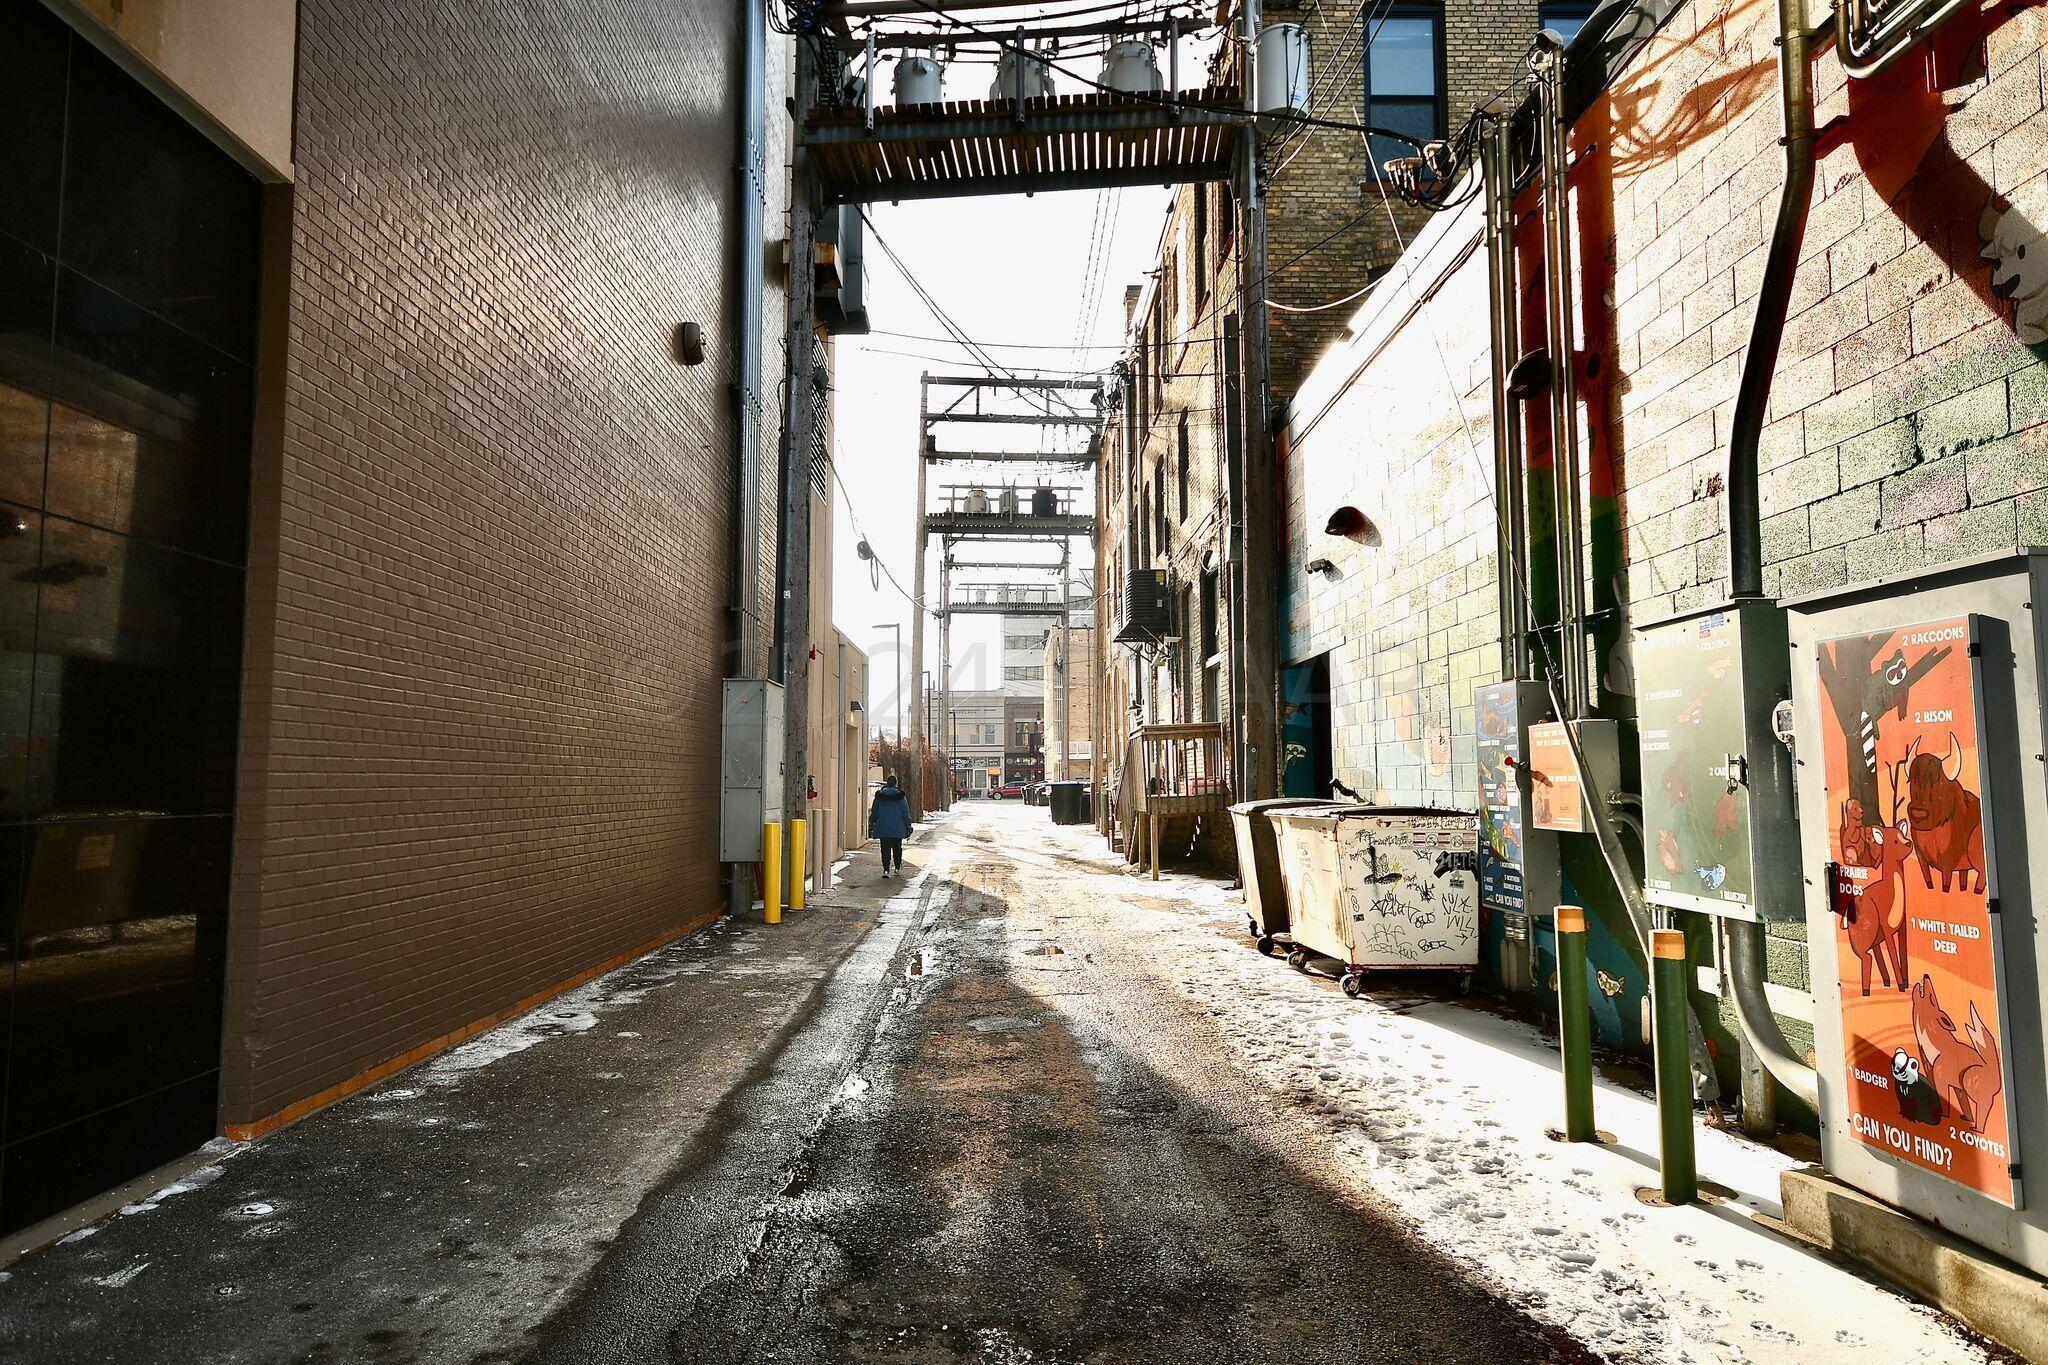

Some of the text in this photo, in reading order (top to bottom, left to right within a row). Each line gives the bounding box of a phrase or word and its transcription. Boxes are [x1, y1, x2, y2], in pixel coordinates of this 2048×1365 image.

[1902, 626, 1965, 647] 2 RACCOONS
[1914, 709, 1953, 724] 2 BISON
[1839, 866, 1869, 880] PRAIRIE
[1839, 883, 1864, 896] DOGS
[1910, 917, 1980, 939] 1 WHITE TAILED
[1933, 939, 1957, 955] DEER
[1848, 1065, 1889, 1090] 1 BADGER
[1852, 1112, 1953, 1171] CAN YOU FIND?
[1950, 1126, 2005, 1158] 2 COYOTES
